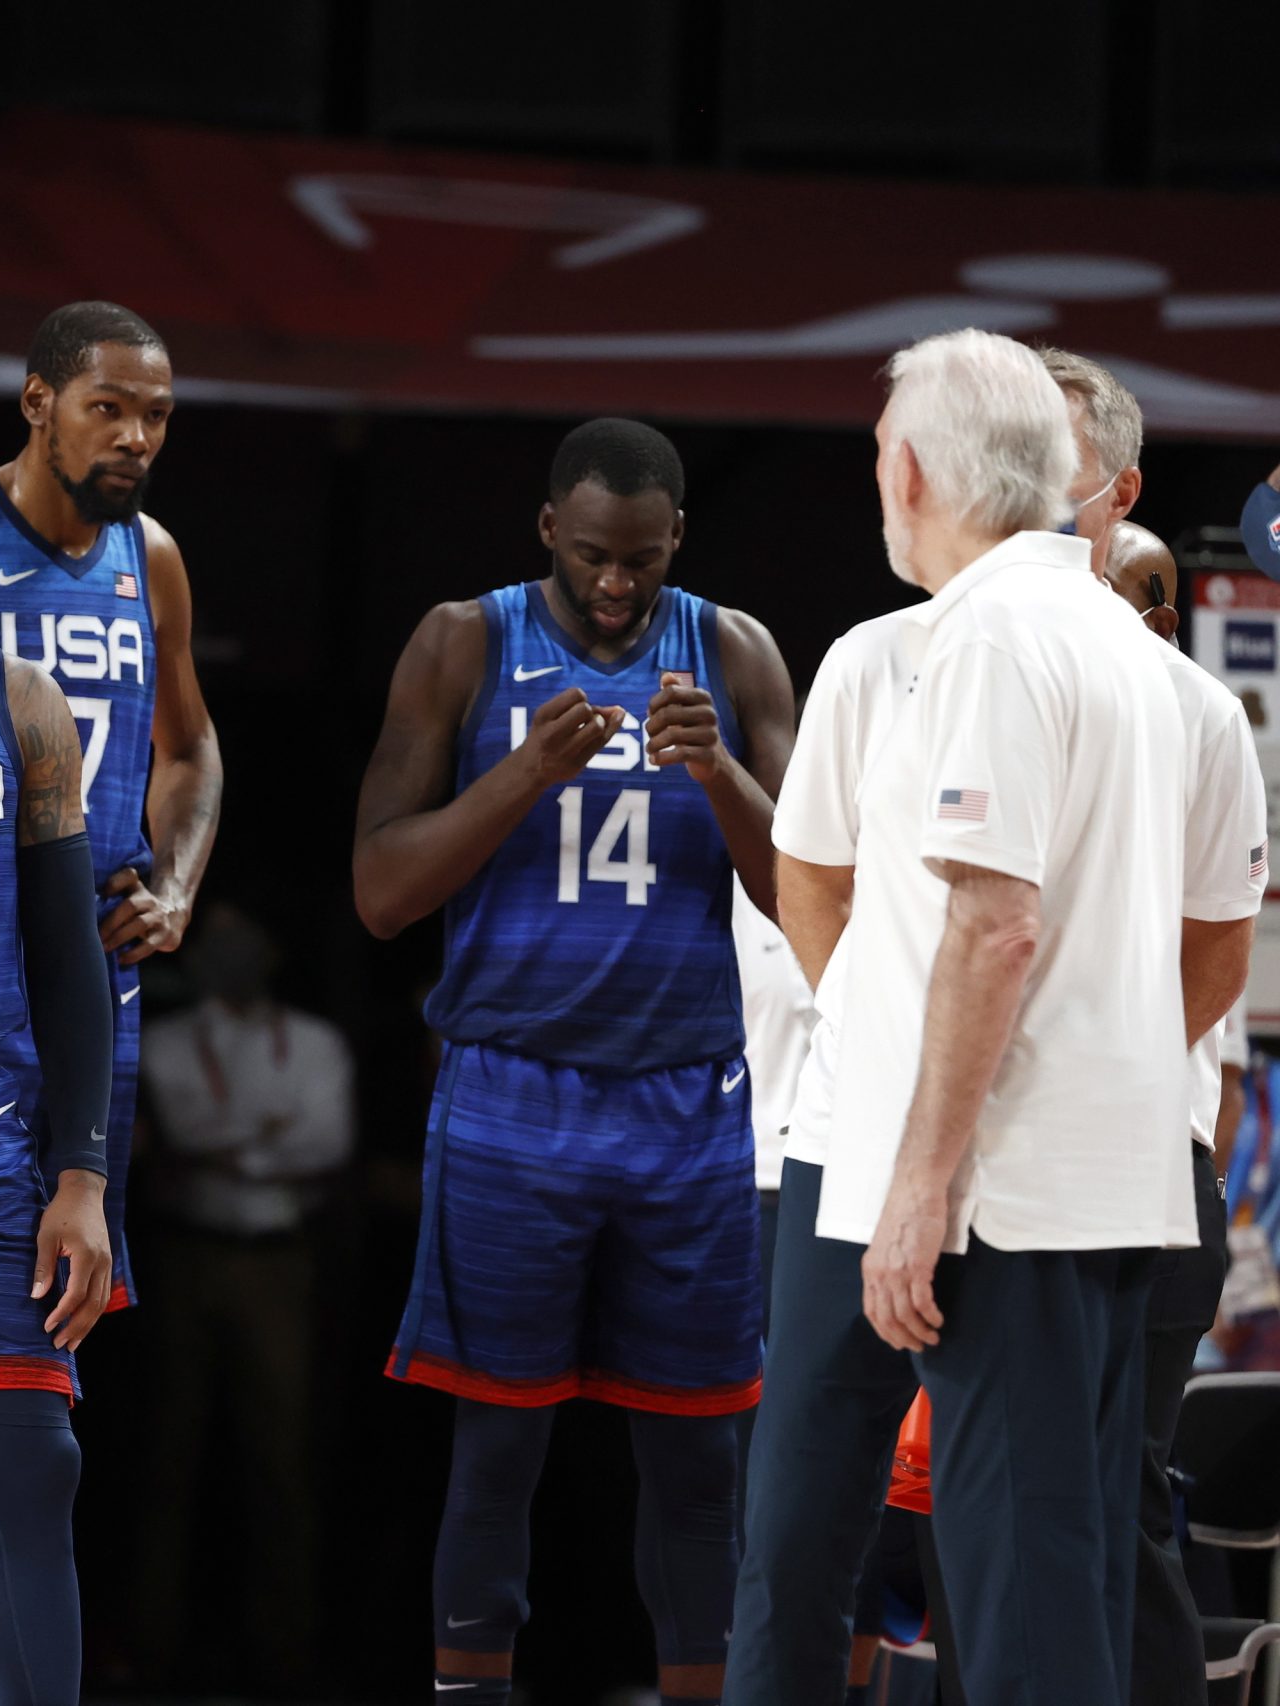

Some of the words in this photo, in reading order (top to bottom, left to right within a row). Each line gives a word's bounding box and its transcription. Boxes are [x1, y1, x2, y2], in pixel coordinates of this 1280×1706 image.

[1, 611, 144, 686] USA
[66, 696, 112, 815] 7
[556, 785, 657, 906] 14
